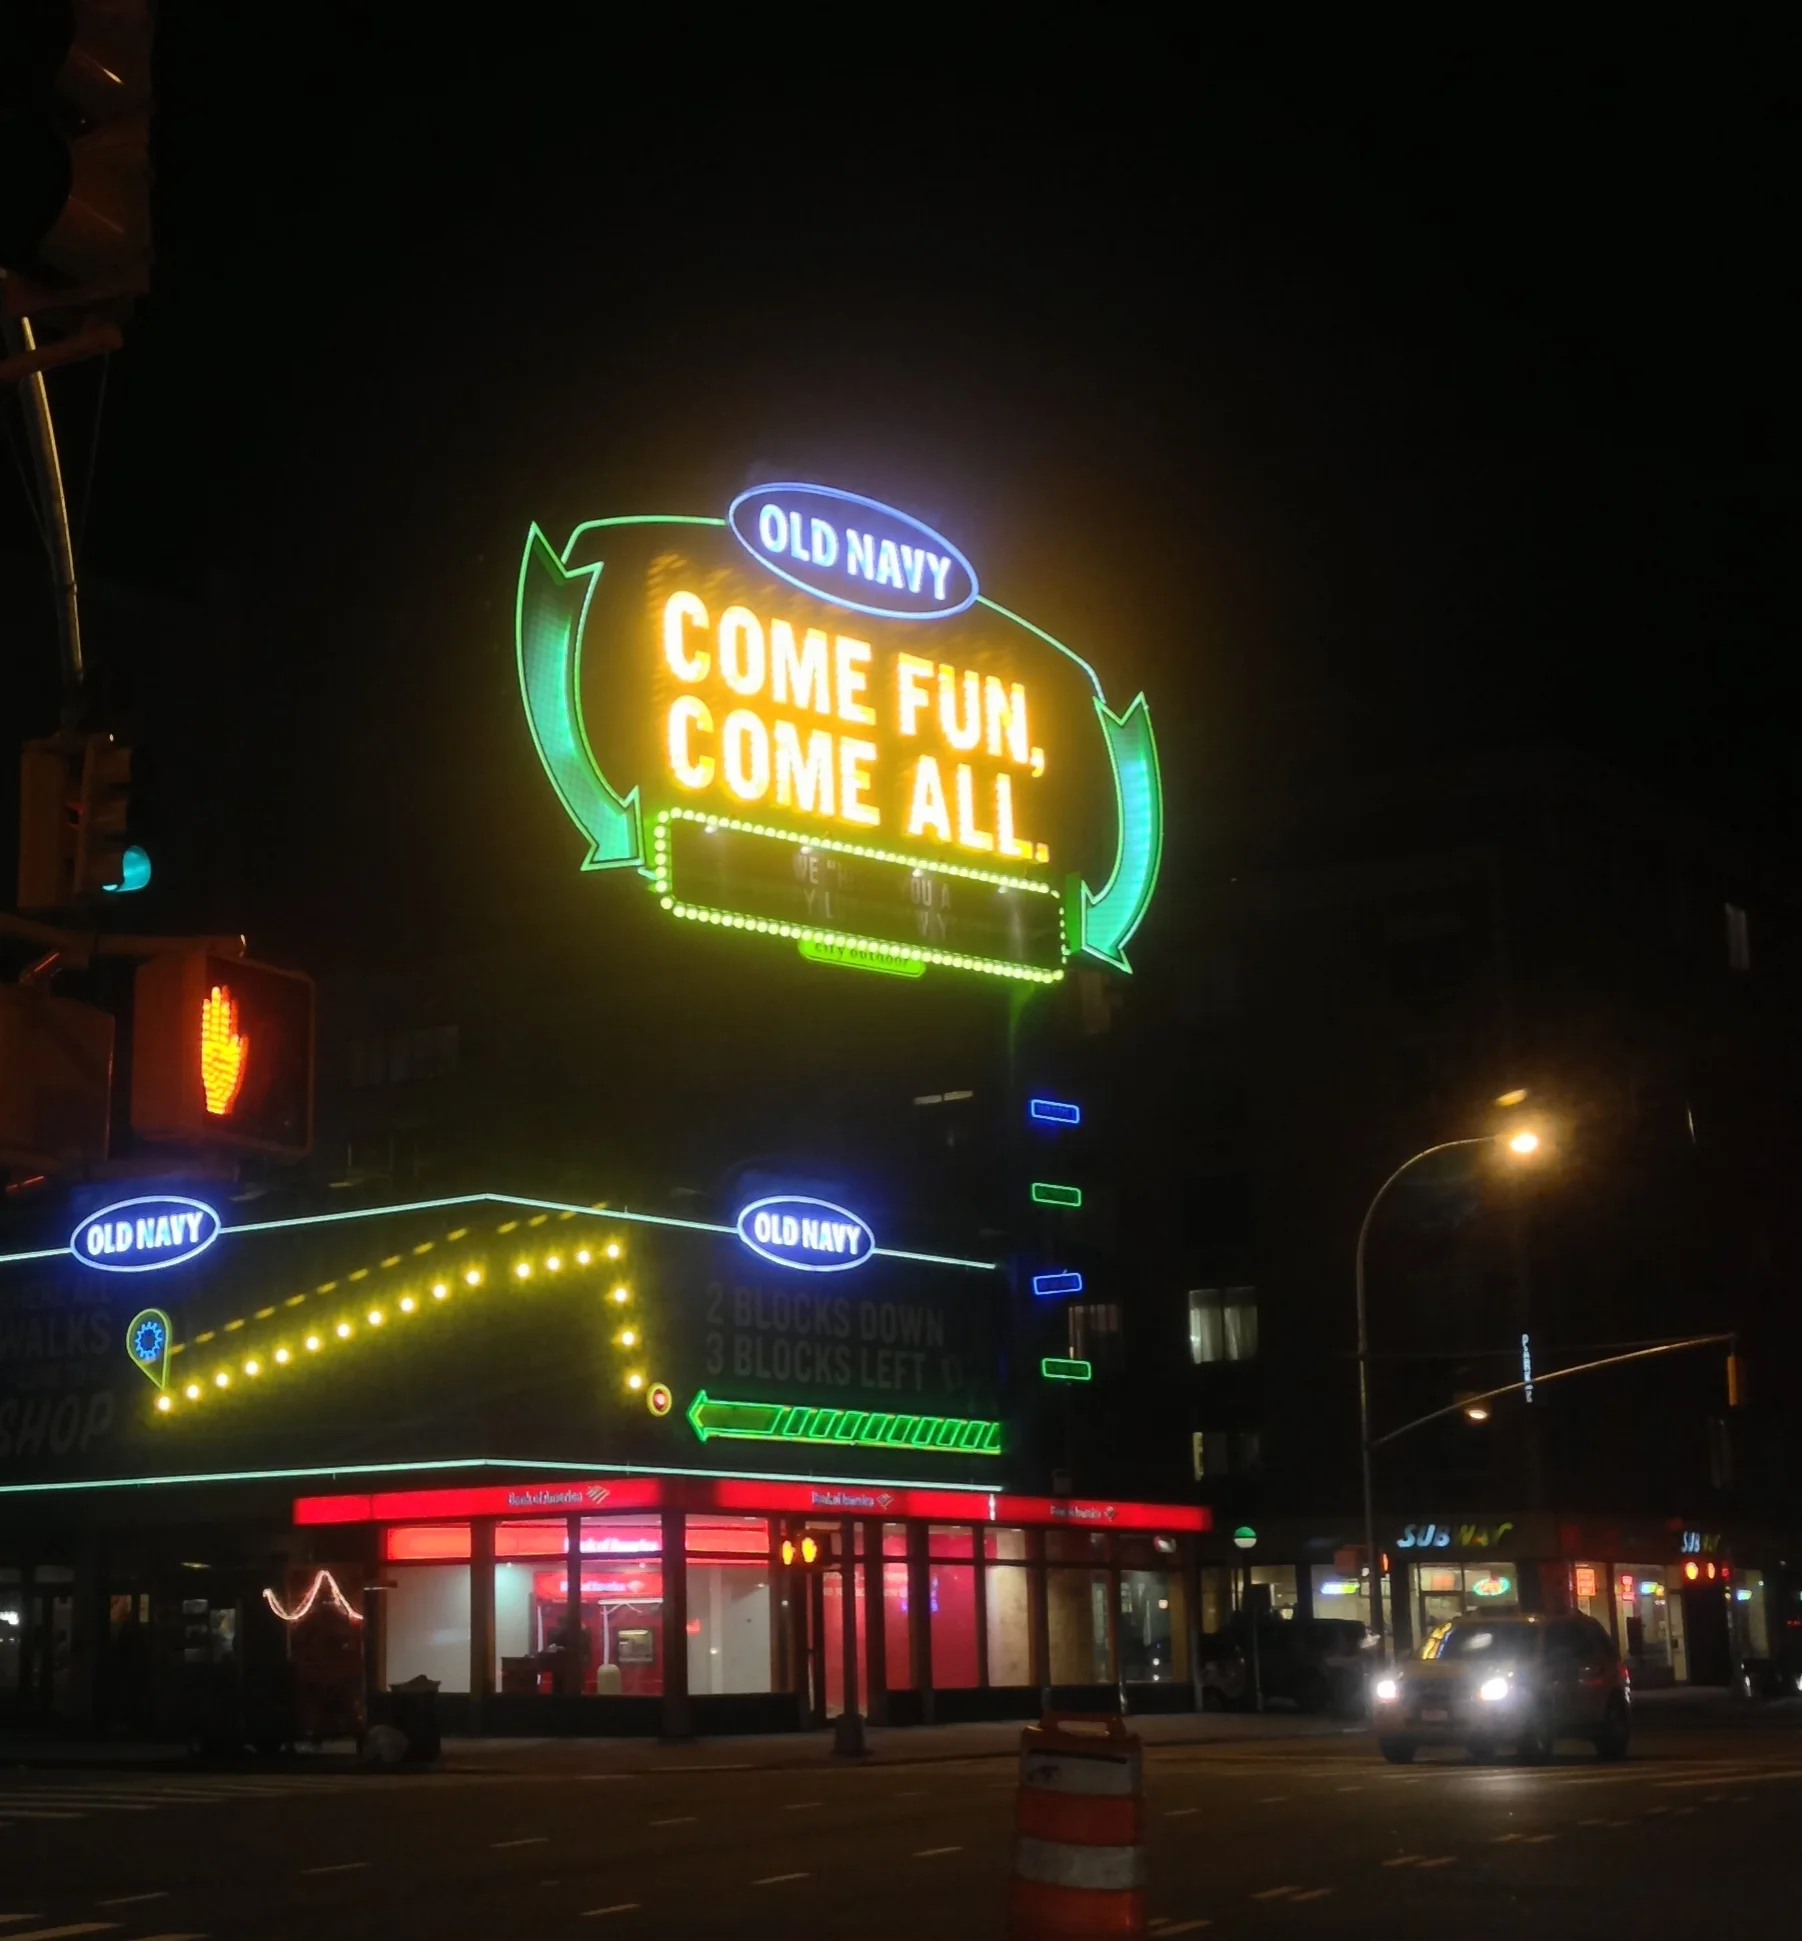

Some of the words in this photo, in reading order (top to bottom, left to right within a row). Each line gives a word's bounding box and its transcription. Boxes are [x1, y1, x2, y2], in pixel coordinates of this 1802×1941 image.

[759, 504, 839, 567] OLD
[846, 528, 951, 600] NAVY
[663, 590, 876, 725] COME
[898, 652, 1045, 777] FUN,
[667, 695, 880, 825] COME
[908, 754, 1050, 862] ALL.
[87, 1222, 133, 1255] OLD
[136, 1211, 204, 1250] NAVY
[754, 1211, 799, 1246] OLD
[802, 1217, 861, 1255] NAVY
[706, 1280, 723, 1325] 2
[734, 1285, 850, 1338] BLOCKS
[860, 1300, 944, 1347] DOWN
[706, 1331, 723, 1374] 3
[734, 1335, 851, 1386] BLOCKS
[861, 1347, 926, 1391] LEFT
